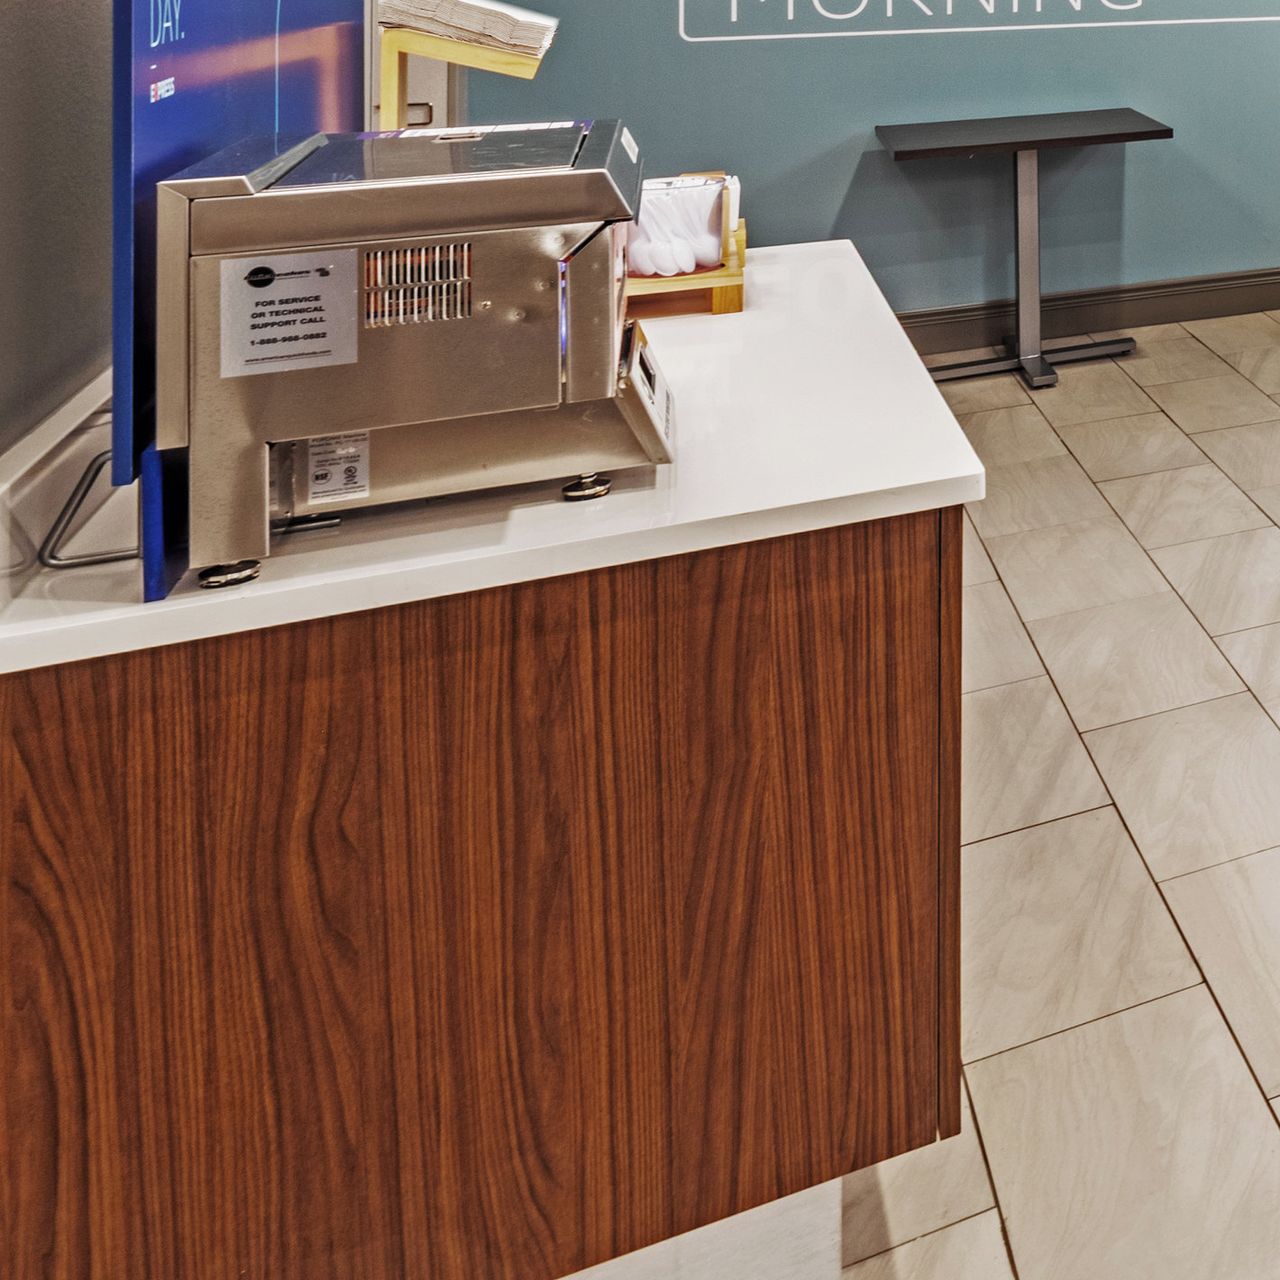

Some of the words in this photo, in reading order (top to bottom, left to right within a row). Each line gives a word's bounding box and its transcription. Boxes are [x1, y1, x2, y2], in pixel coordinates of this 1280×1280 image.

[278, 295, 321, 305] SERVICE
[269, 306, 325, 317] TECHNICAL
[250, 320, 298, 330] SUPPORT
